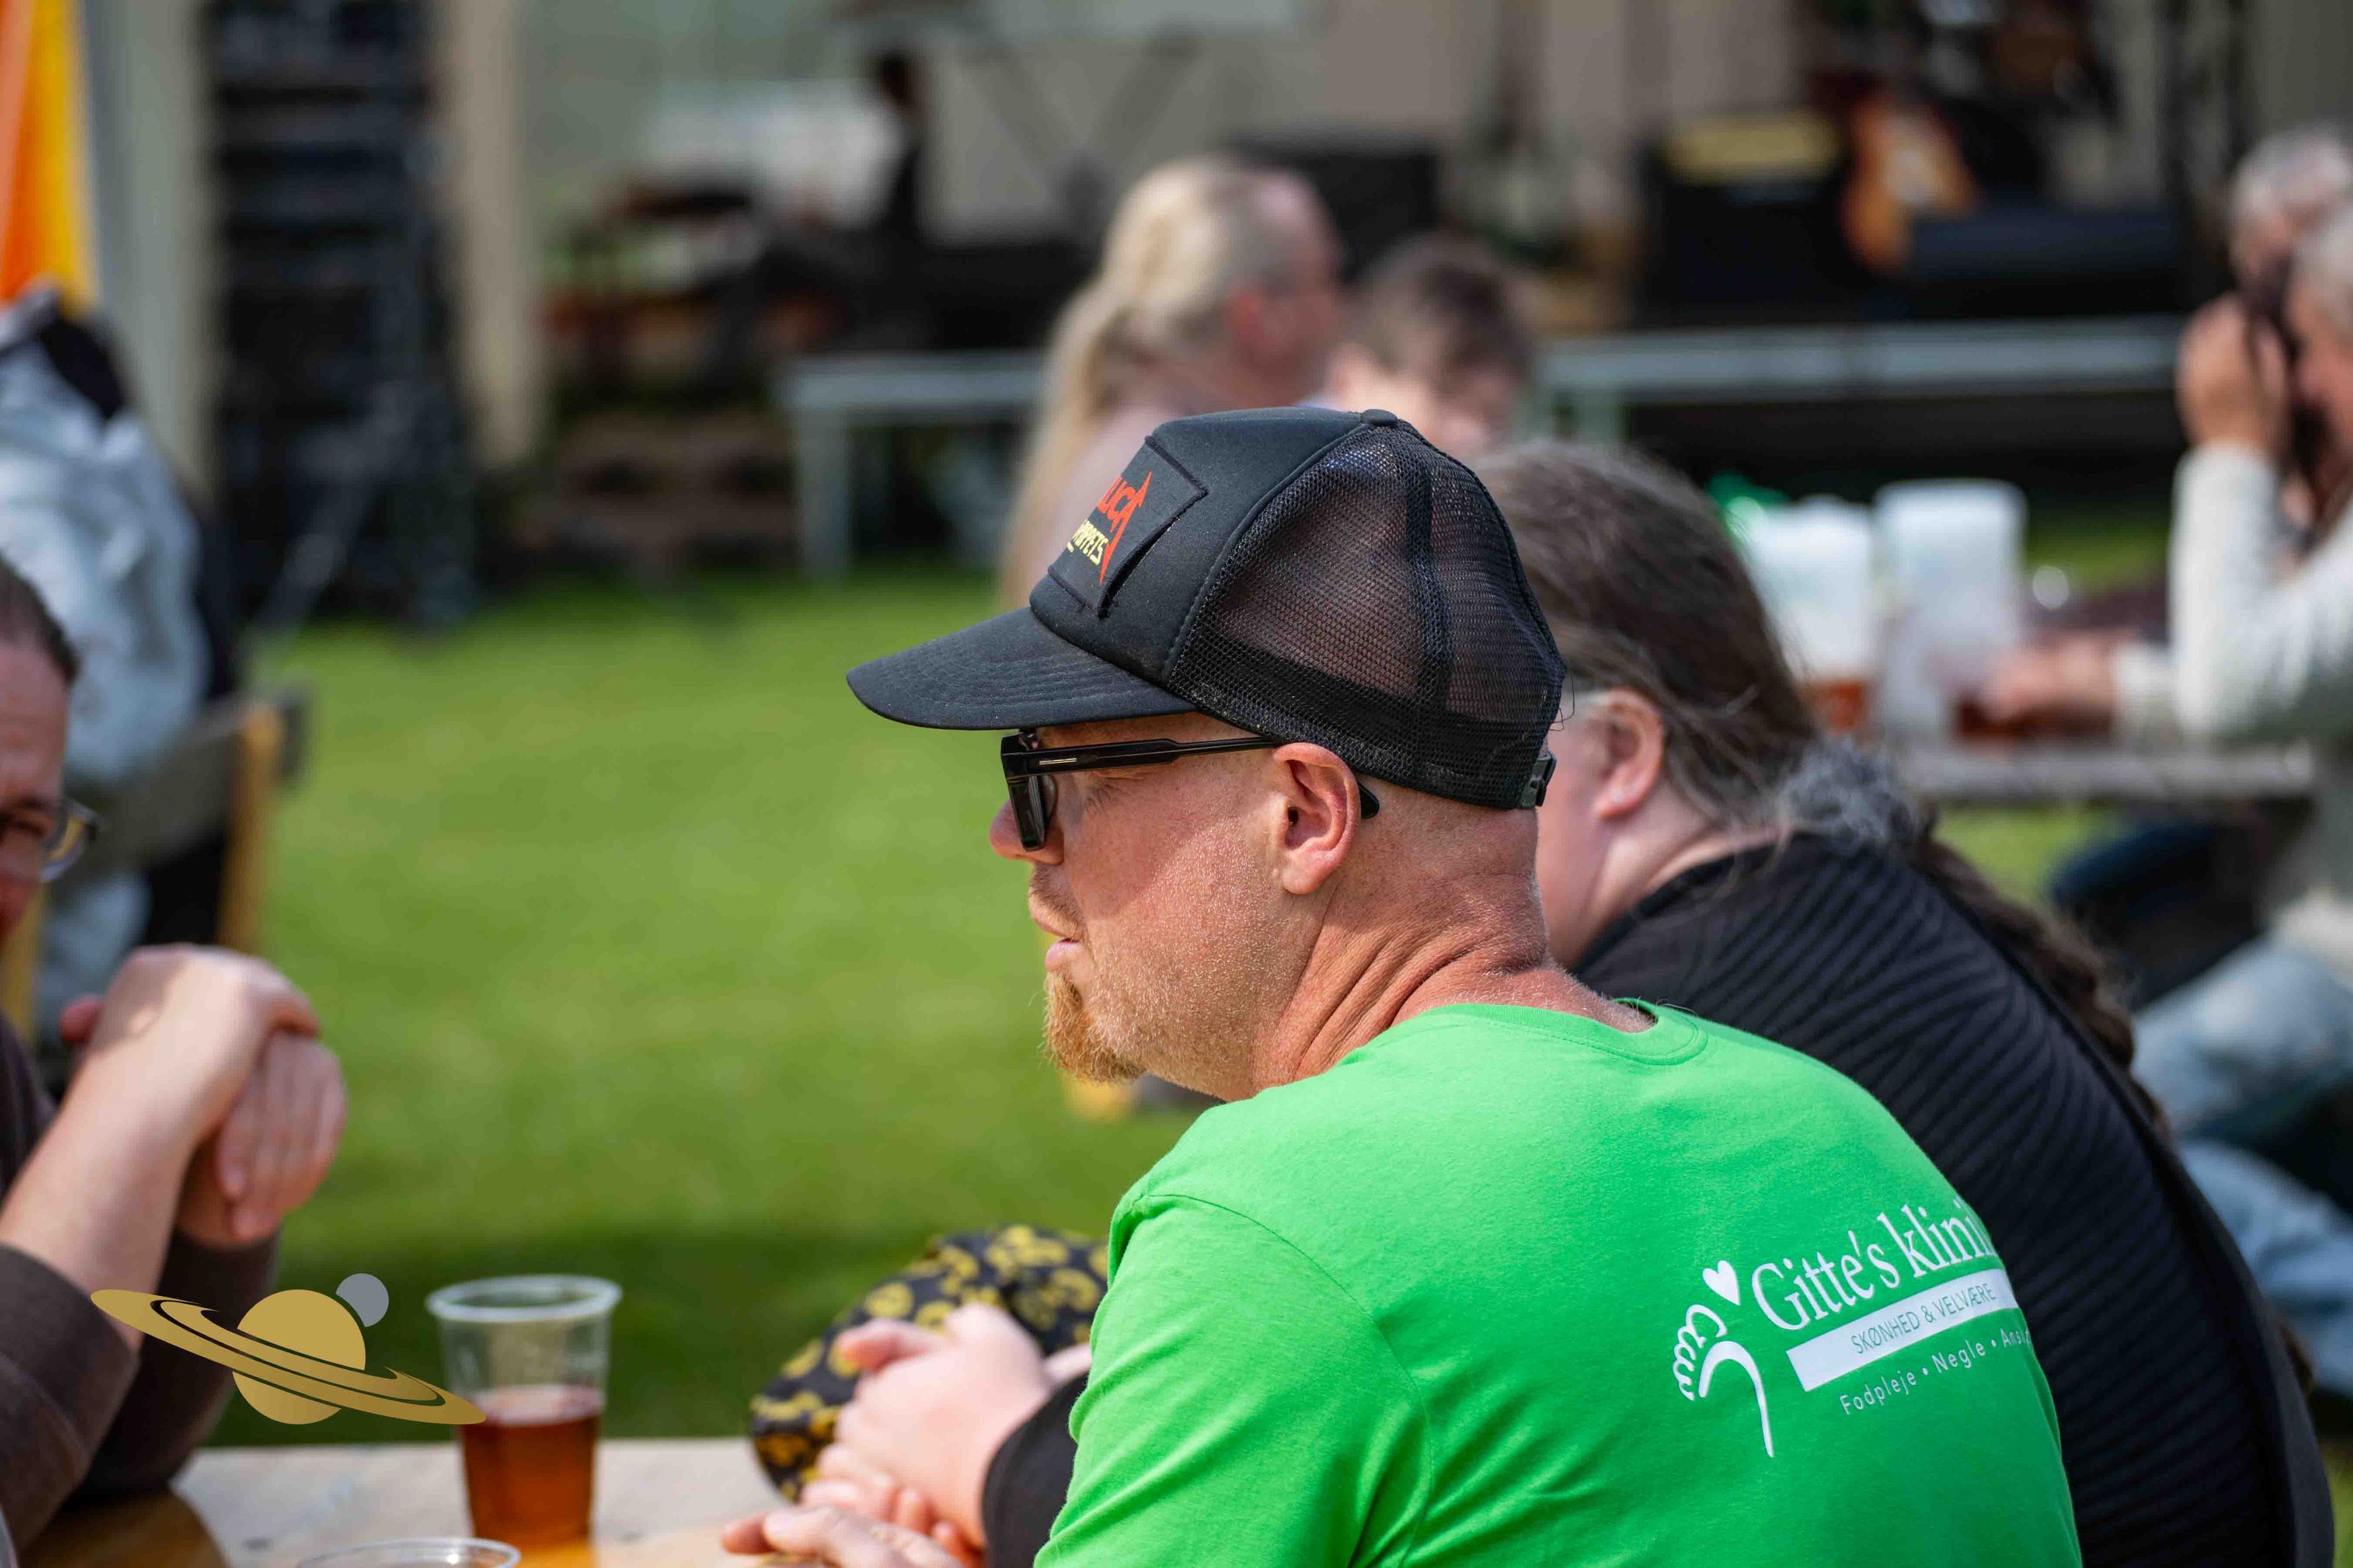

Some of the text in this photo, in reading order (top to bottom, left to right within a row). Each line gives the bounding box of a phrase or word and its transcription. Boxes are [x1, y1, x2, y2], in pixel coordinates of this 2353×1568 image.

[1752, 1231, 1902, 1331] Gitte's
[1851, 1284, 1996, 1355] SKØNHED & VELVÆRE
[1840, 1372, 1917, 1415] Fodpleje
[1931, 1339, 1986, 1375] Negle
